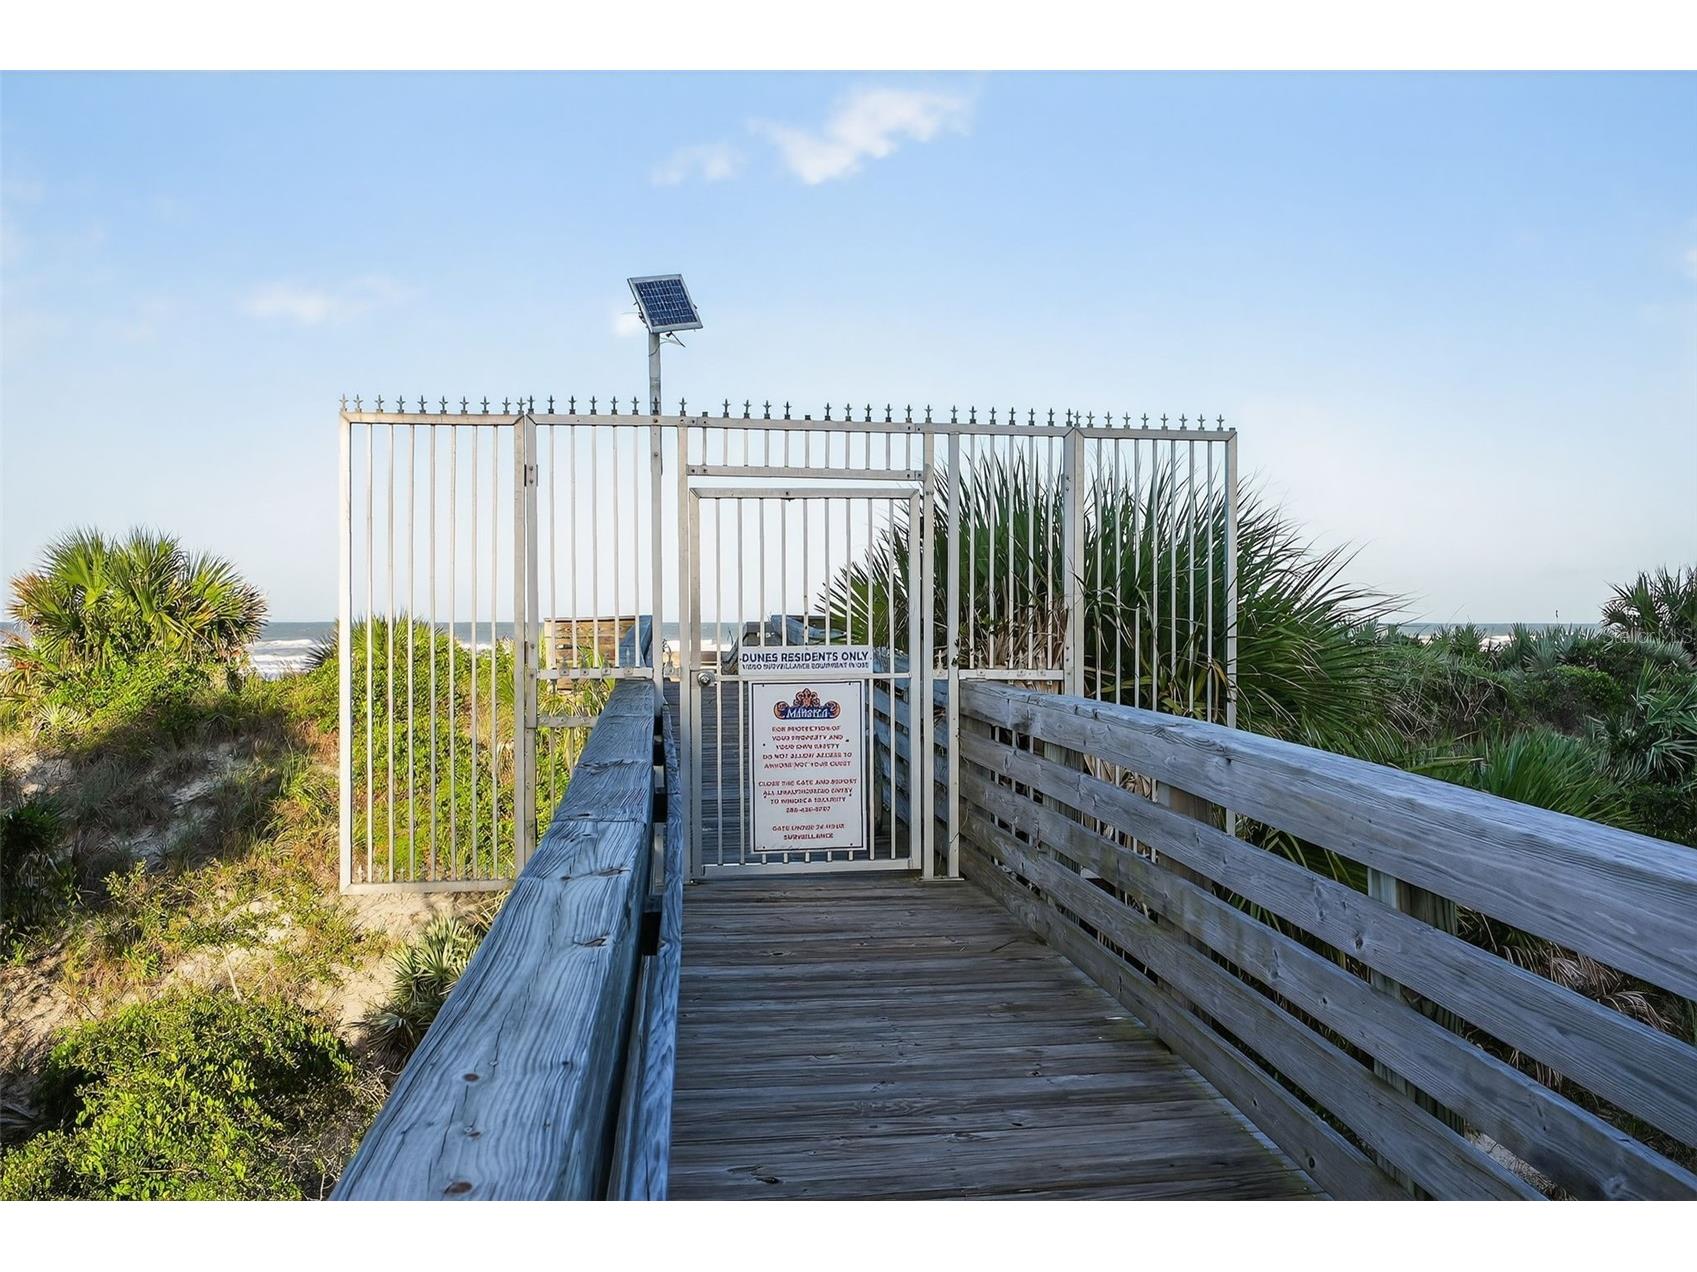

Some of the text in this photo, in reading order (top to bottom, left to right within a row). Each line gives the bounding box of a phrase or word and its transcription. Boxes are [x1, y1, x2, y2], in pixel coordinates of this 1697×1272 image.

[742, 651, 869, 662] DUNES RESIDENTS ONLY
